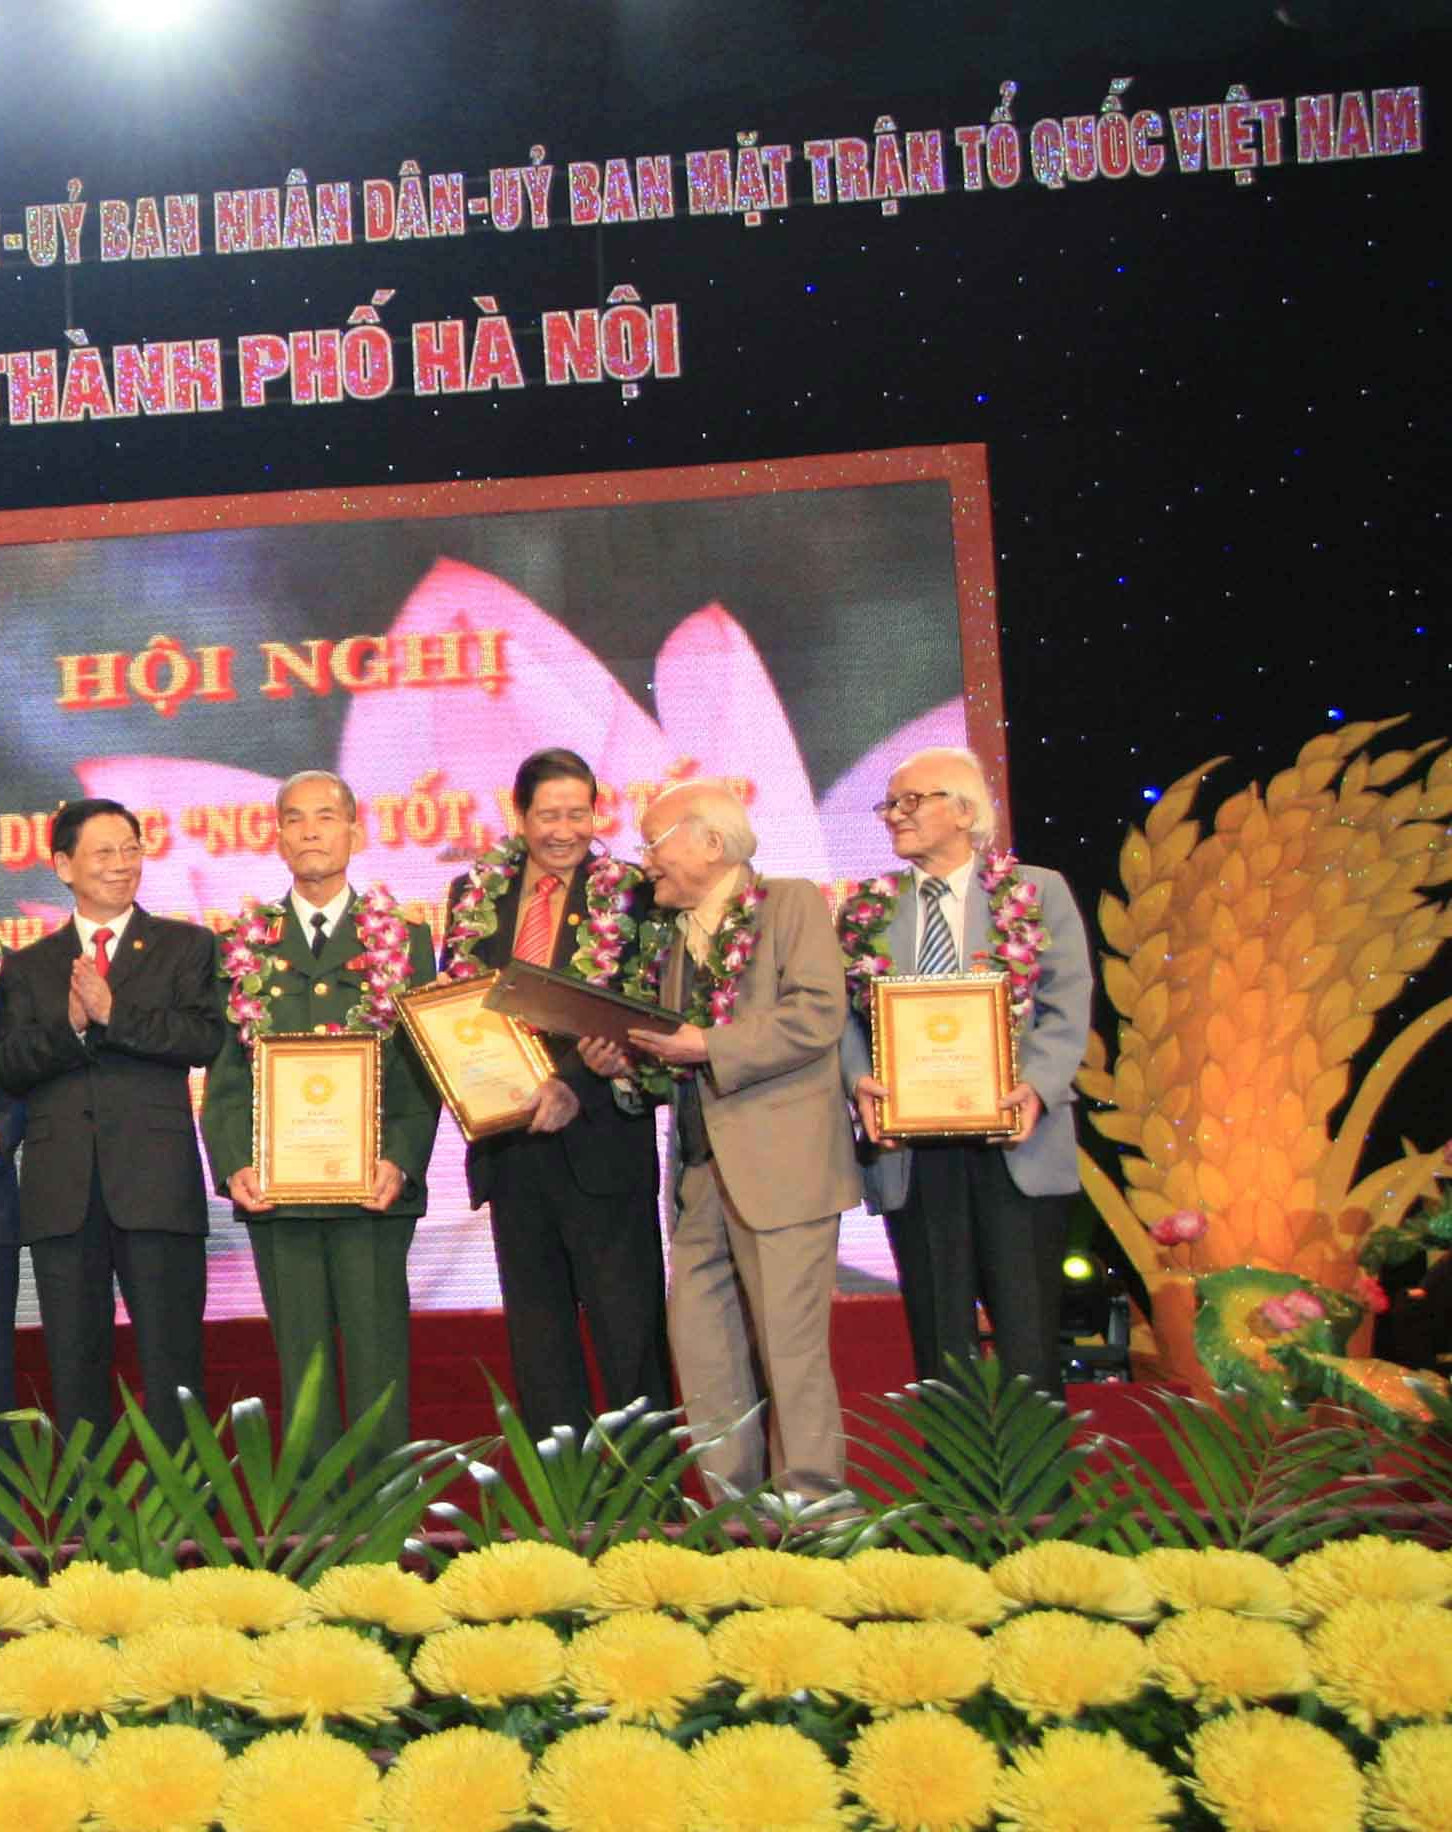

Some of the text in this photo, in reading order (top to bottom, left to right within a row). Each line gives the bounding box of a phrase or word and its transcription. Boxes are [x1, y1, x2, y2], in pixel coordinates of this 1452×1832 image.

[100, 194, 200, 262] BAN
[215, 168, 354, 254] NHÂN
[568, 154, 675, 225] BAN
[685, 130, 792, 227] MẶT
[803, 114, 946, 216] TRẬN
[954, 79, 1023, 190] TỔ
[1030, 76, 1166, 190] QUỐC
[1168, 84, 1287, 186] VIỆT
[1295, 86, 1424, 164] NAM
[238, 288, 396, 408] PHỐ
[411, 295, 525, 397] HÀ
[542, 283, 681, 399] NỘI
[55, 629, 510, 718] HỘI NGHỊ
